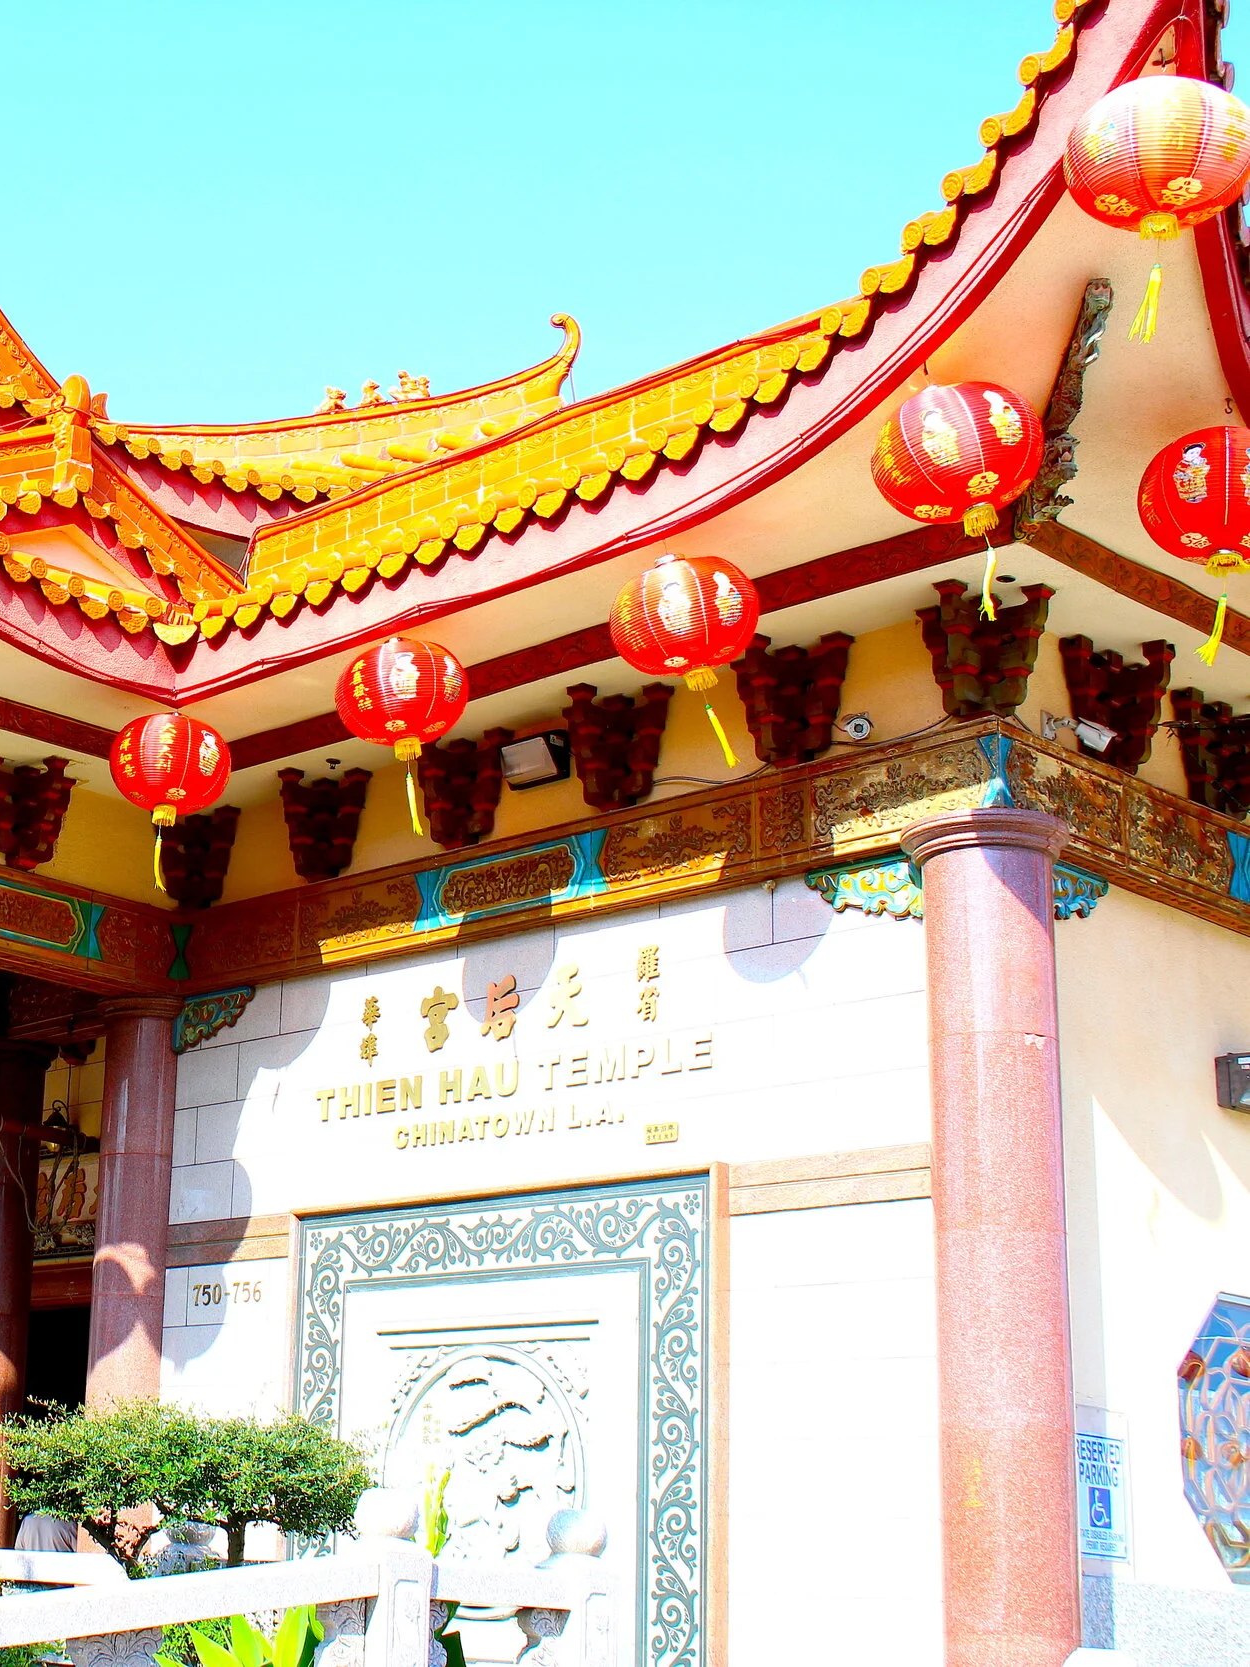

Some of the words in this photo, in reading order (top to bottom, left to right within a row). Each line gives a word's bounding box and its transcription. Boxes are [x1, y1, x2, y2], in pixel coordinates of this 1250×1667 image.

[315, 1075, 423, 1122] THIEN
[439, 1059, 520, 1105] HAU
[538, 1031, 714, 1092] TEMPLE
[393, 1106, 555, 1150] CHINATOWN
[567, 1101, 625, 1130] L.A.
[1078, 1462, 1119, 1488] PARKING
